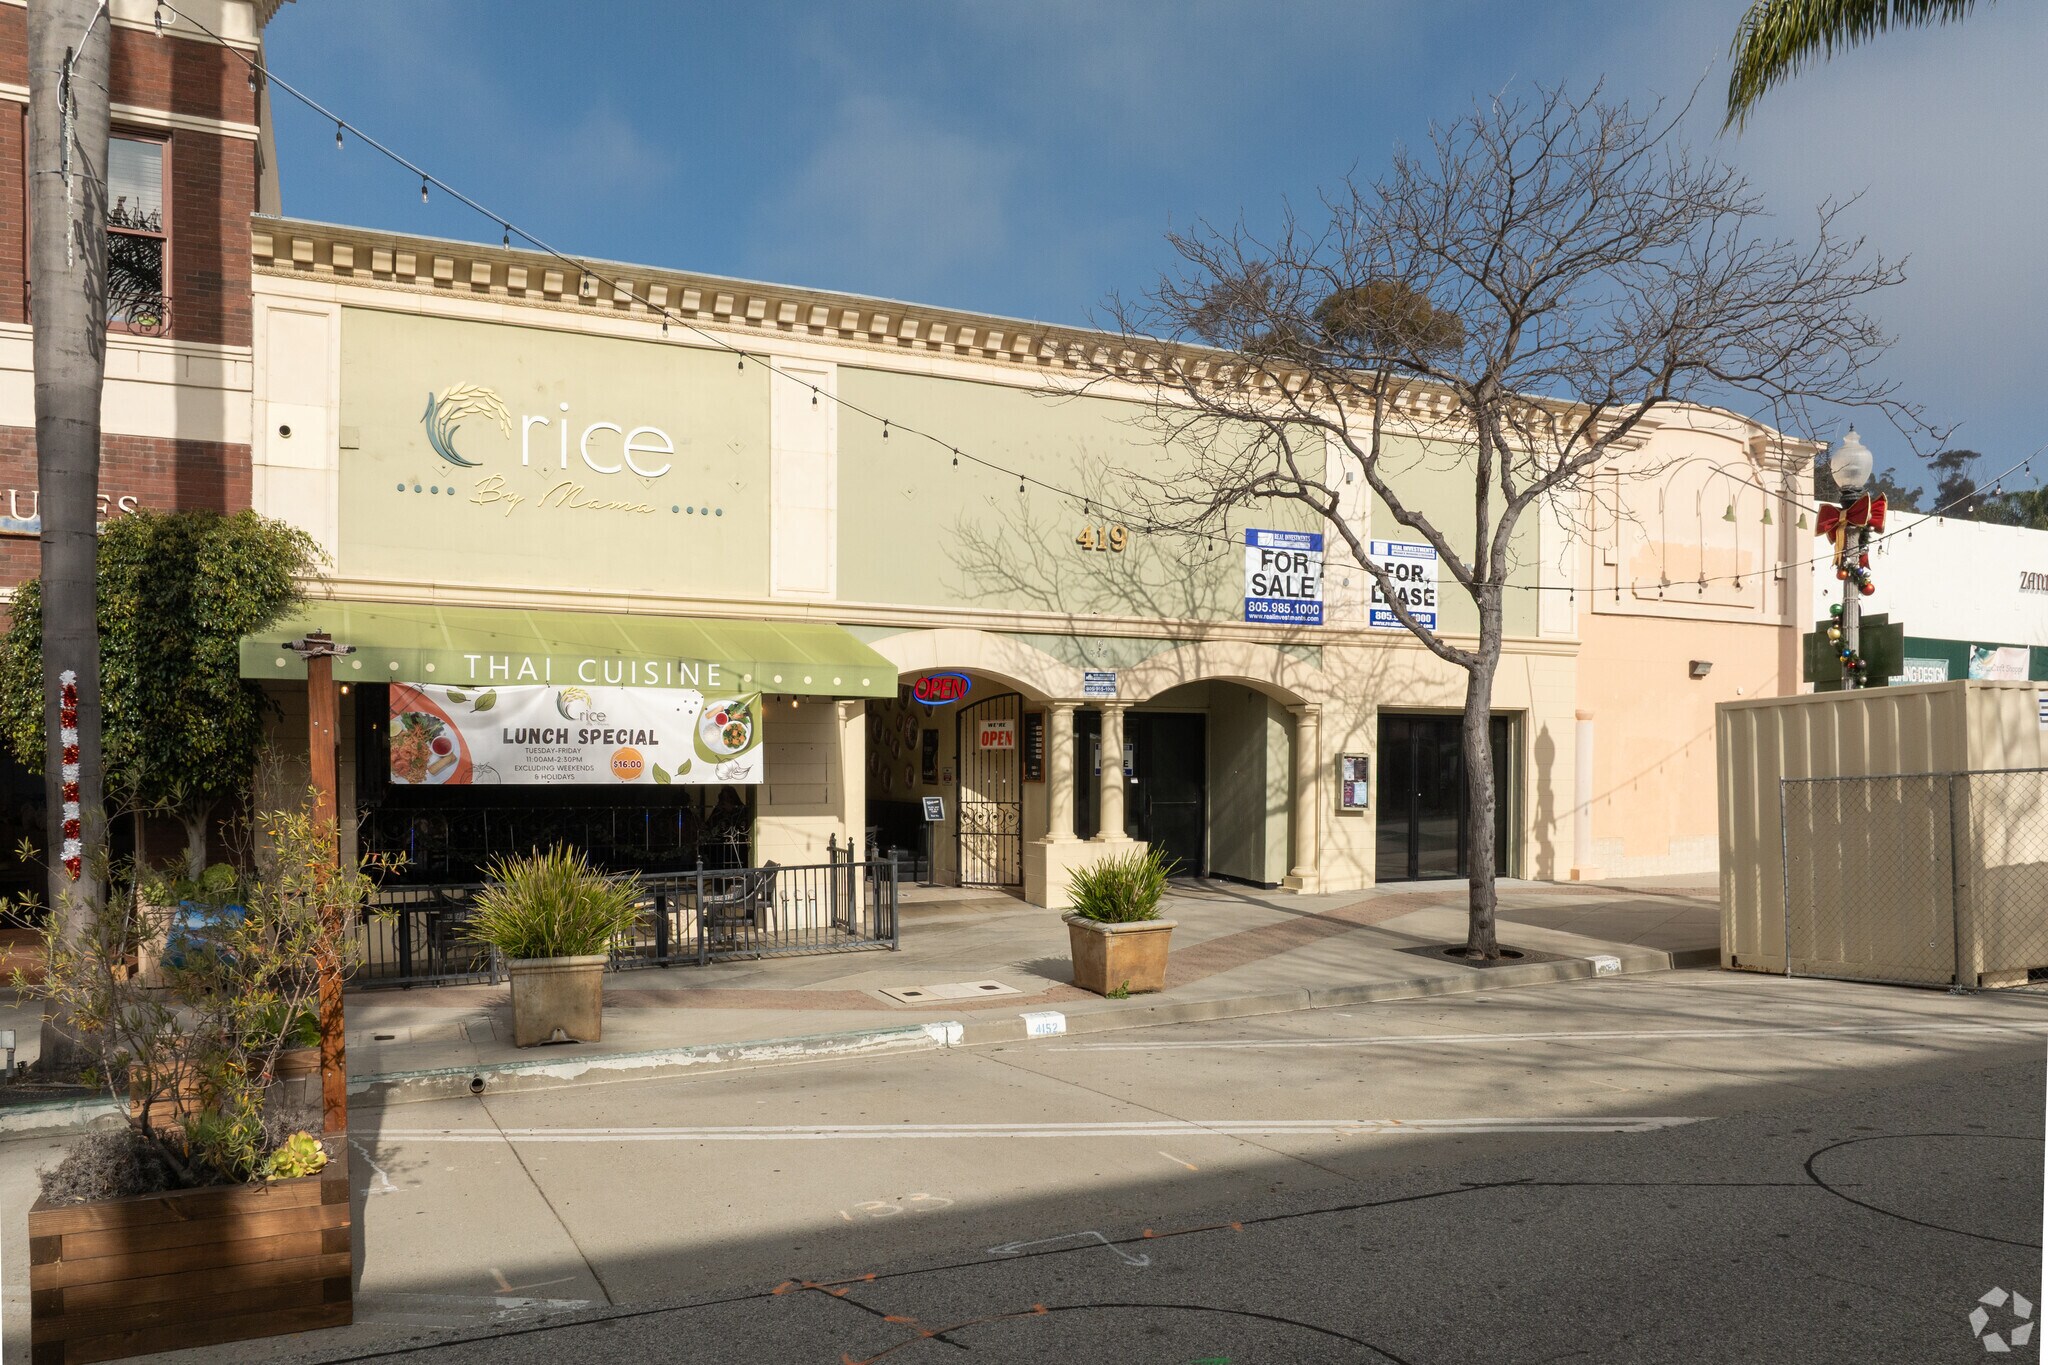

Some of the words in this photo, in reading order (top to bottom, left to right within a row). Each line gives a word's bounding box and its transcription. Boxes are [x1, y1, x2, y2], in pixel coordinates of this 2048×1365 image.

[522, 402, 674, 478] rice
[469, 473, 525, 516] By
[537, 480, 656, 514] Mama
[1076, 524, 1127, 553] 419
[1261, 549, 1309, 575] FOR
[1384, 562, 1424, 583] FOR
[1251, 573, 1315, 598] SALE
[1248, 601, 1320, 615] 805.985.1000
[464, 655, 550, 680] THAI
[578, 659, 721, 686] CUISINE
[915, 677, 966, 700] OPEN
[579, 709, 606, 722] rice
[503, 728, 569, 744] LUNCH
[578, 728, 659, 745] SPECIAL
[981, 730, 1013, 747] OPEN
[613, 760, 642, 769] $16.00
[1035, 1023, 1057, 1035] 4152
